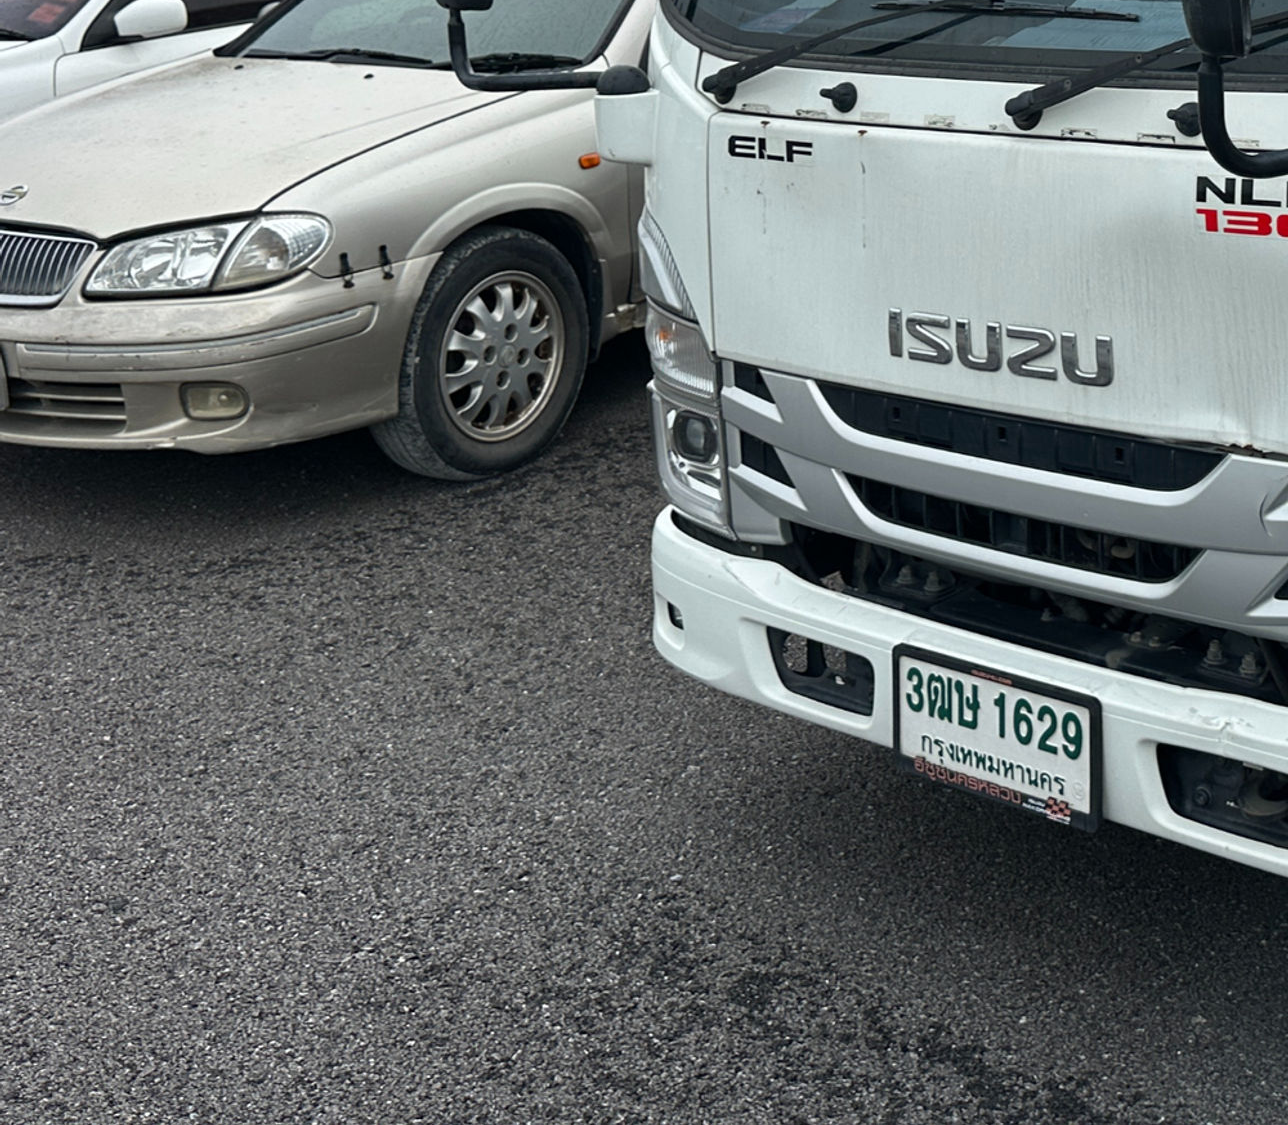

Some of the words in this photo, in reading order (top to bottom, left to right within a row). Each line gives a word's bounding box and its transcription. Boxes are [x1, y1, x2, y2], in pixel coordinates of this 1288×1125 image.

[728, 135, 813, 163] ELF
[887, 307, 1115, 387] ISUZU
[906, 666, 981, 730] 3ฒษ
[993, 691, 1083, 761] 1629
[921, 734, 1066, 796] กรุงเทพมหานคร
